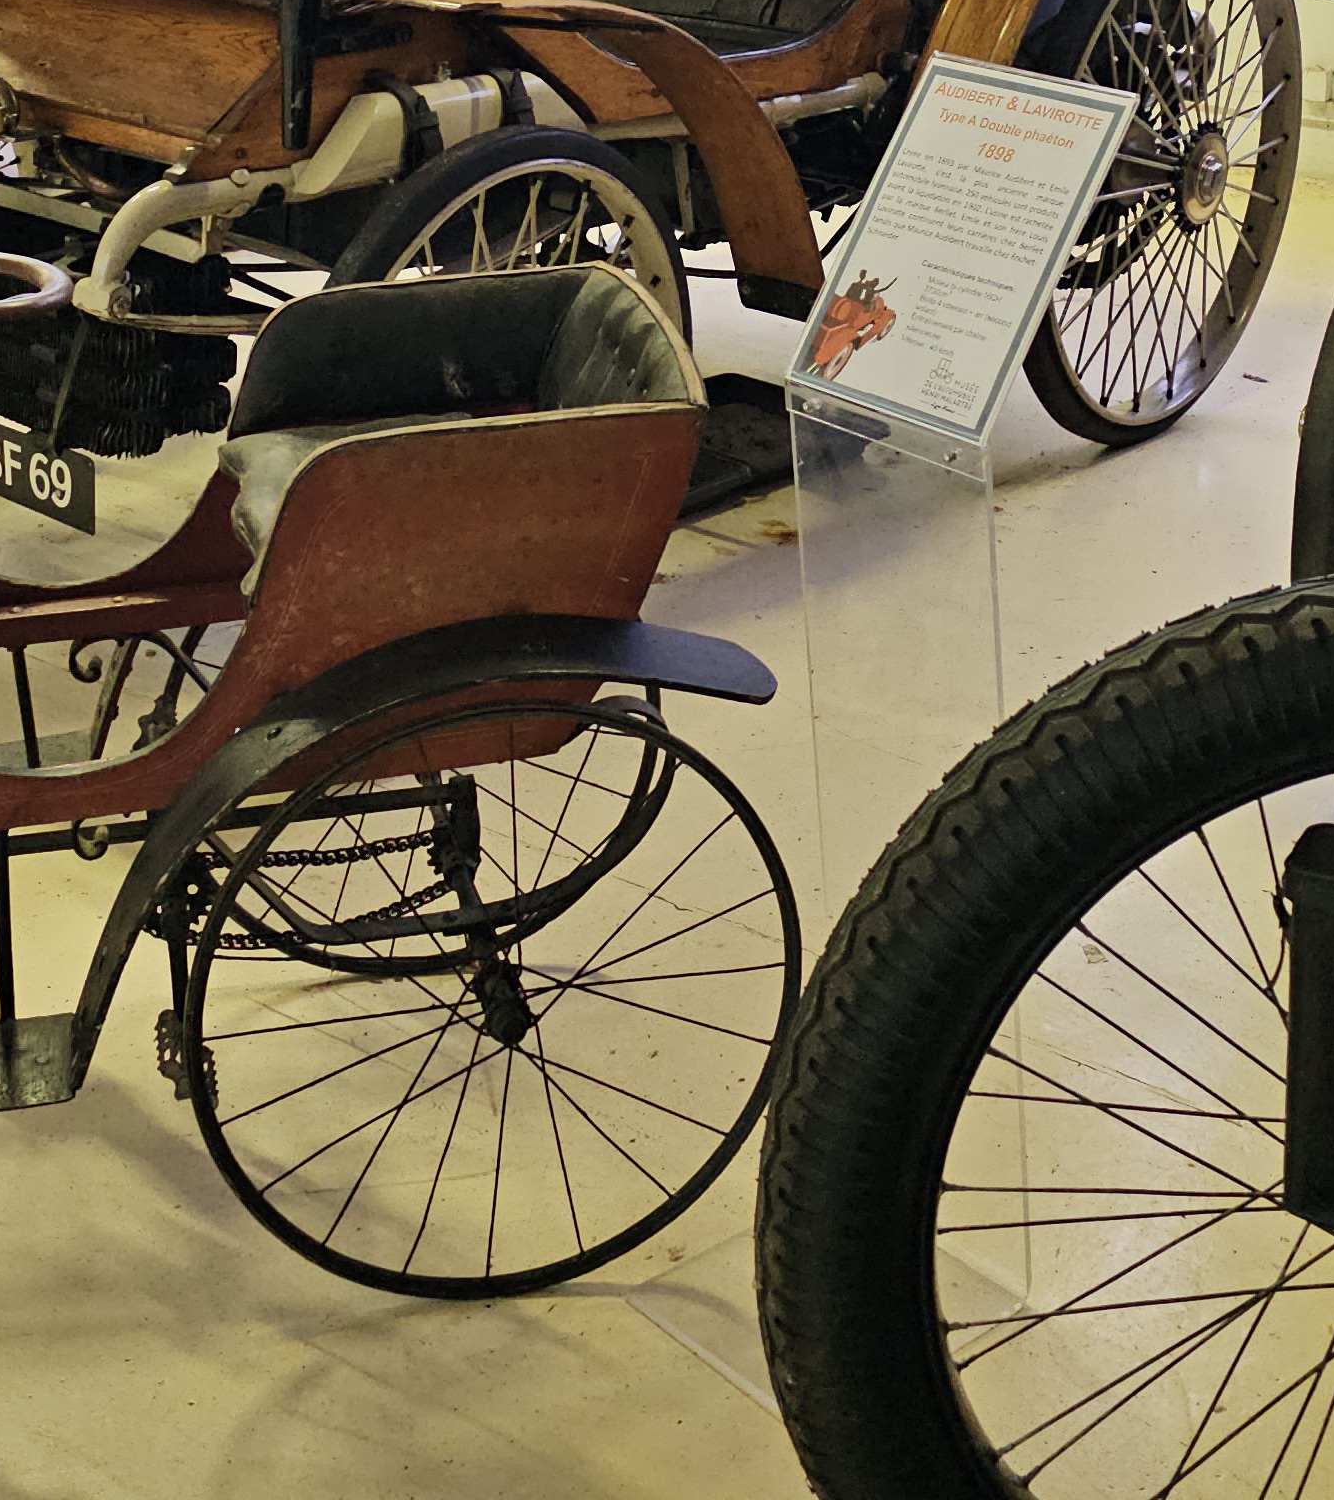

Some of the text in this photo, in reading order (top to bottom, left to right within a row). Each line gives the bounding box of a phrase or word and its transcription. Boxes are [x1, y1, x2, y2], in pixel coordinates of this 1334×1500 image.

[935, 81, 1103, 130] AUDIBERT & LAVIROTTE
[937, 108, 1074, 150] Type A Double phaéton
[976, 142, 1014, 162] 1898
[957, 162, 969, 171] par
[973, 165, 1001, 178] Maurice
[1004, 173, 1034, 186] Audibert
[974, 178, 989, 188] plus
[997, 184, 1028, 197] ancienne
[1035, 194, 1064, 208] marque
[887, 181, 906, 191] avant
[915, 188, 950, 204] liquidation
[1010, 214, 1021, 222] est
[892, 170, 929, 185] automobile
[1013, 201, 1027, 210] sont
[1028, 205, 1058, 220] produits
[872, 214, 892, 225] tandis
[893, 220, 906, 230] que
[907, 224, 933, 237] Maurice
[934, 232, 964, 246] Audibert
[965, 240, 993, 254] travaille
[993, 248, 1009, 259] chez
[882, 192, 893, 201] par
[905, 198, 931, 211] marque
[994, 222, 1007, 231] son
[1029, 232, 1048, 243] Louis
[946, 222, 964, 233] leurs
[1000, 237, 1015, 247] chez
[1019, 243, 1042, 255] Berliet
[954, 377, 979, 394] MUSÉE
[29, 453, 72, 509] 69
